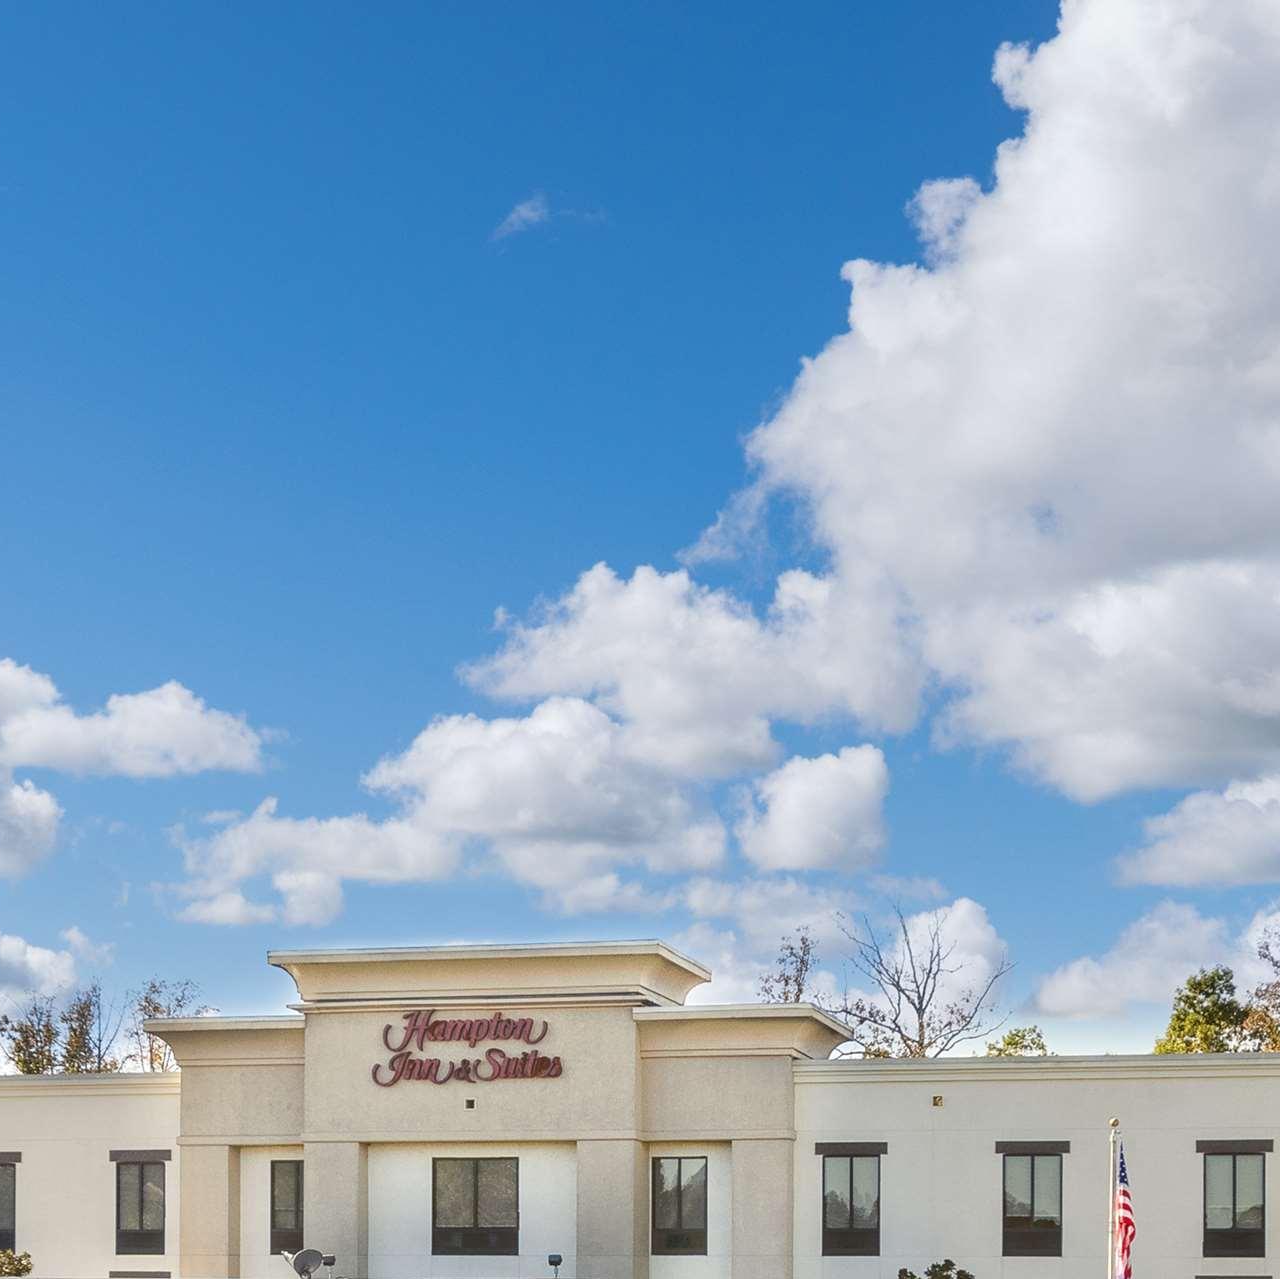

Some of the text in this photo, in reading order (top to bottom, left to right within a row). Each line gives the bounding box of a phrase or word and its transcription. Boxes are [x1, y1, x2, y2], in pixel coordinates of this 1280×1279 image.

[383, 1009, 548, 1051] Hampton
[372, 1048, 562, 1087] Inn & Suites
